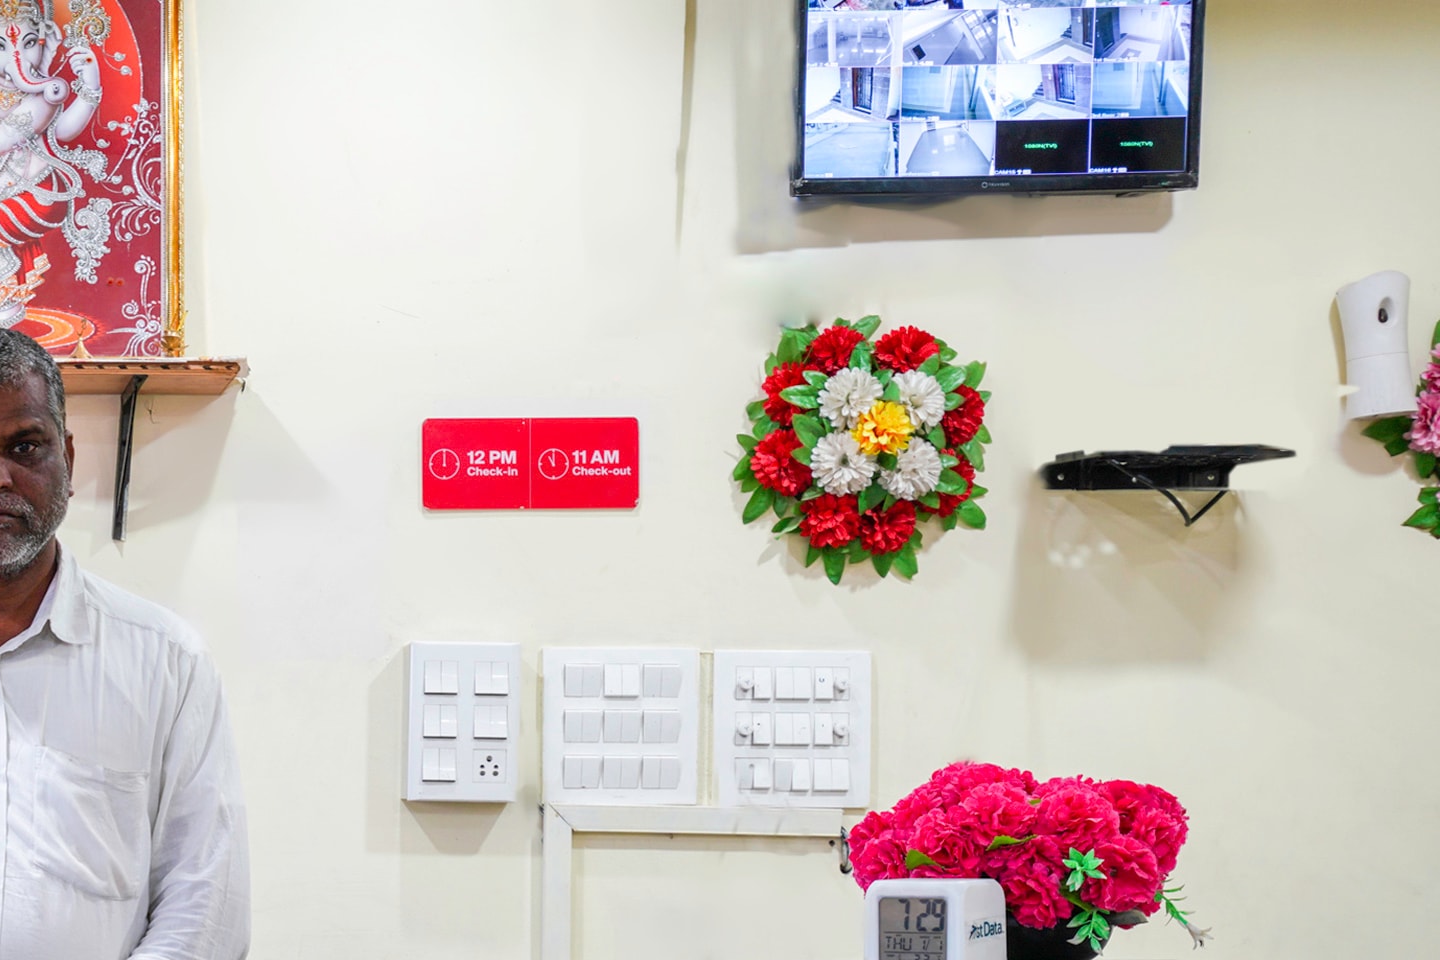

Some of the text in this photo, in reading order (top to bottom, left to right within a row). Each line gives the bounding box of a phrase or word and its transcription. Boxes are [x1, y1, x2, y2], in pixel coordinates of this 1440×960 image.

[467, 450, 517, 465] 12 PM
[572, 450, 620, 464] 11 AM
[467, 466, 518, 477] Check-in
[572, 466, 632, 476] Check-out
[885, 936, 912, 951] THU
